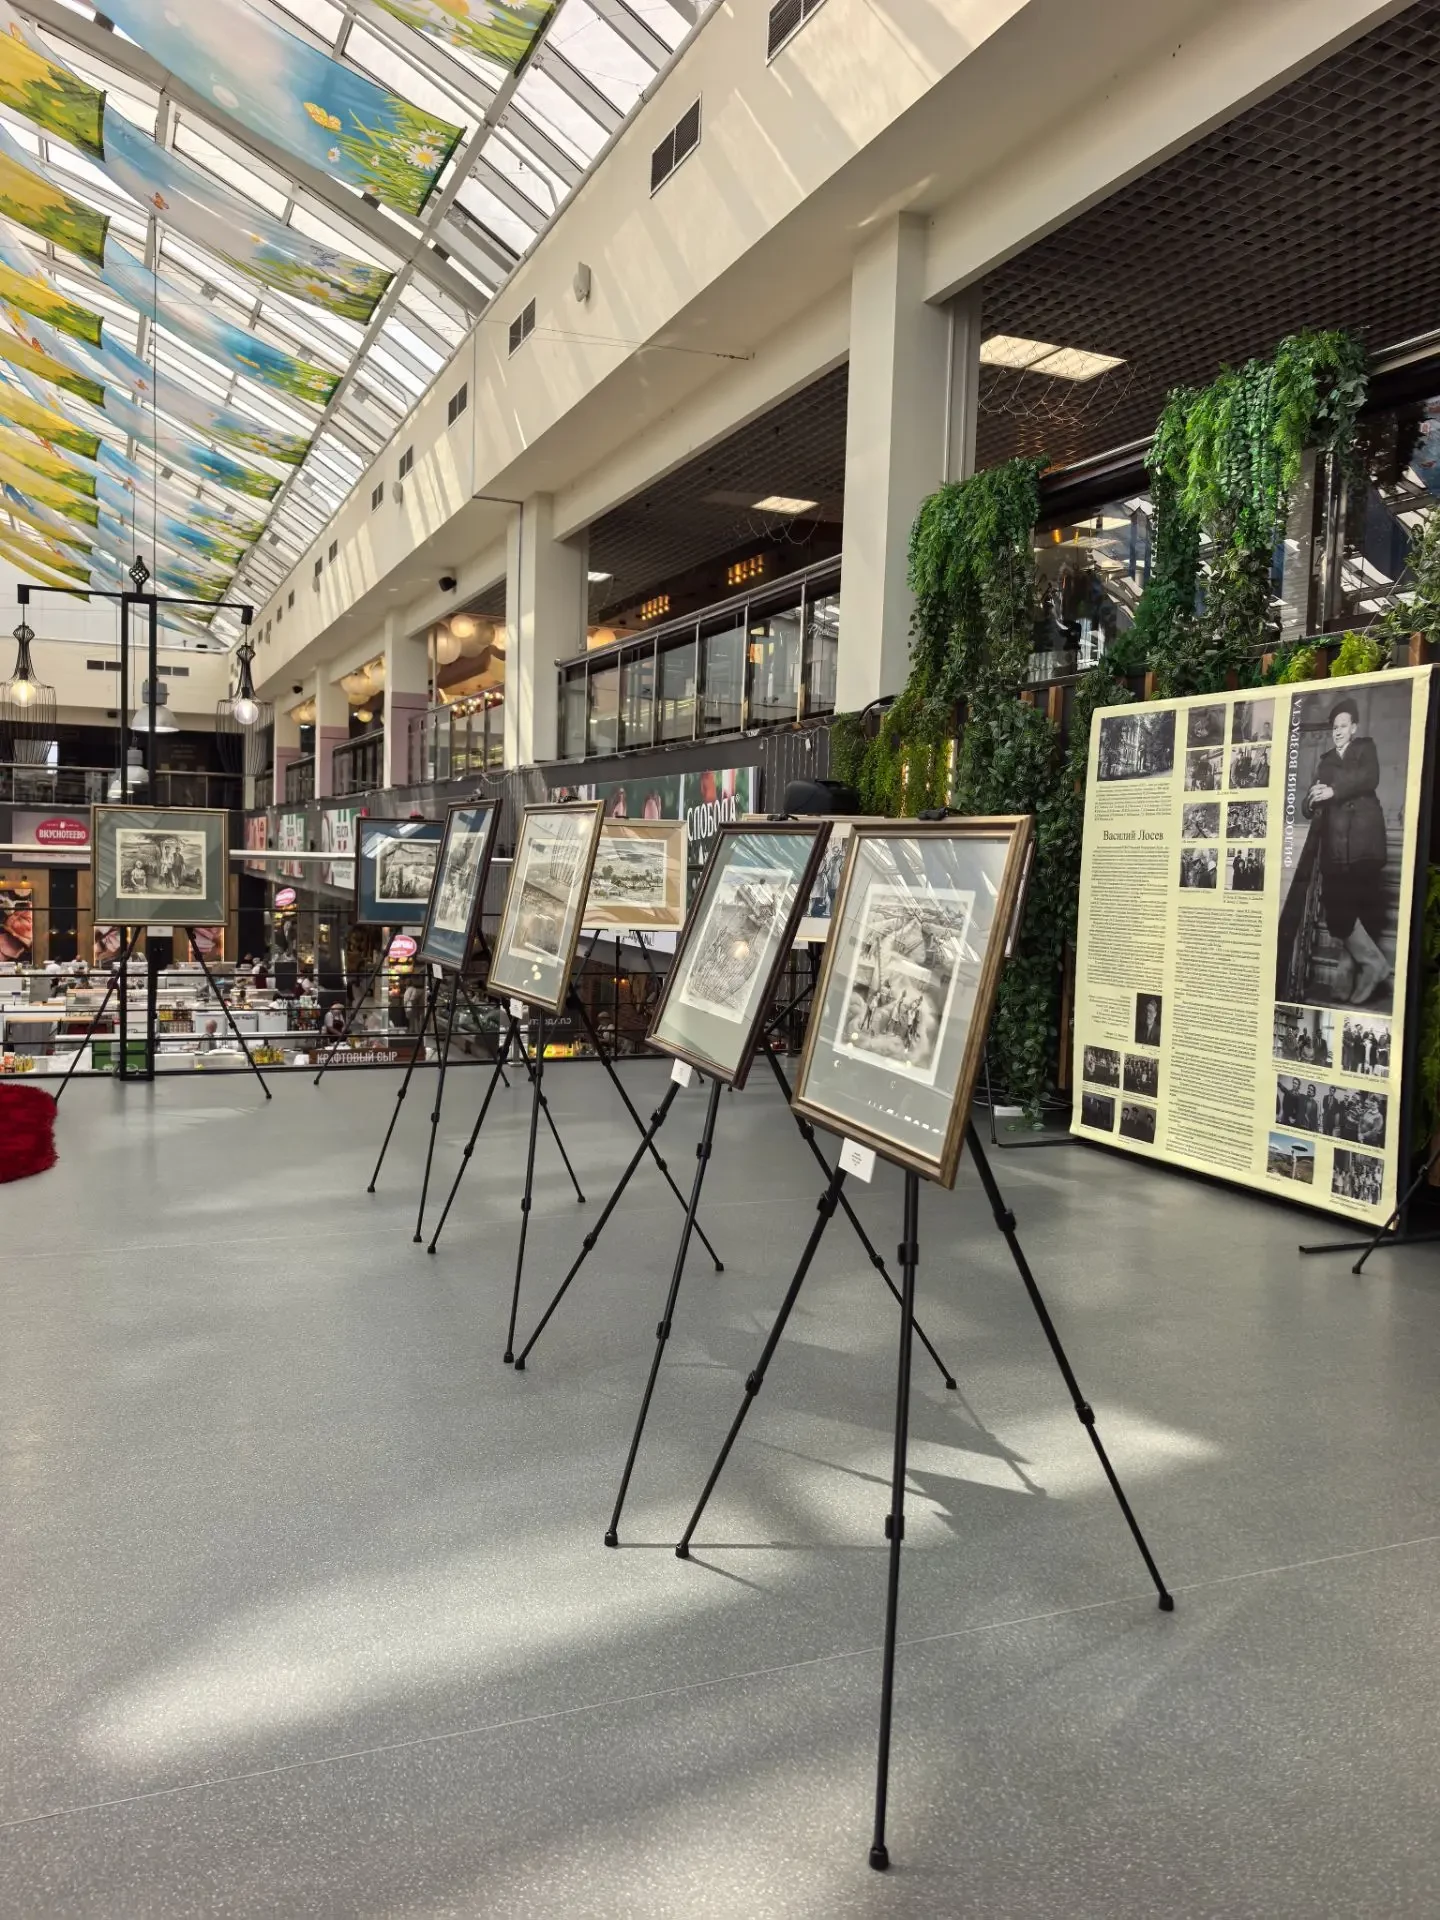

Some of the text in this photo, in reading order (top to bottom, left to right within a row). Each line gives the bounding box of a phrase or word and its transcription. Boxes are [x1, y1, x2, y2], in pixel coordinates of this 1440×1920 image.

[1283, 699, 1303, 868] ФИЛОСОФИЯ ВОЗРАСТА
[39, 829, 86, 840] ВКУСНОТЕЕВО
[1103, 829, 1164, 841] Василий Лосев
[317, 1050, 398, 1064] КРАФТОВЫЙ СЫР
